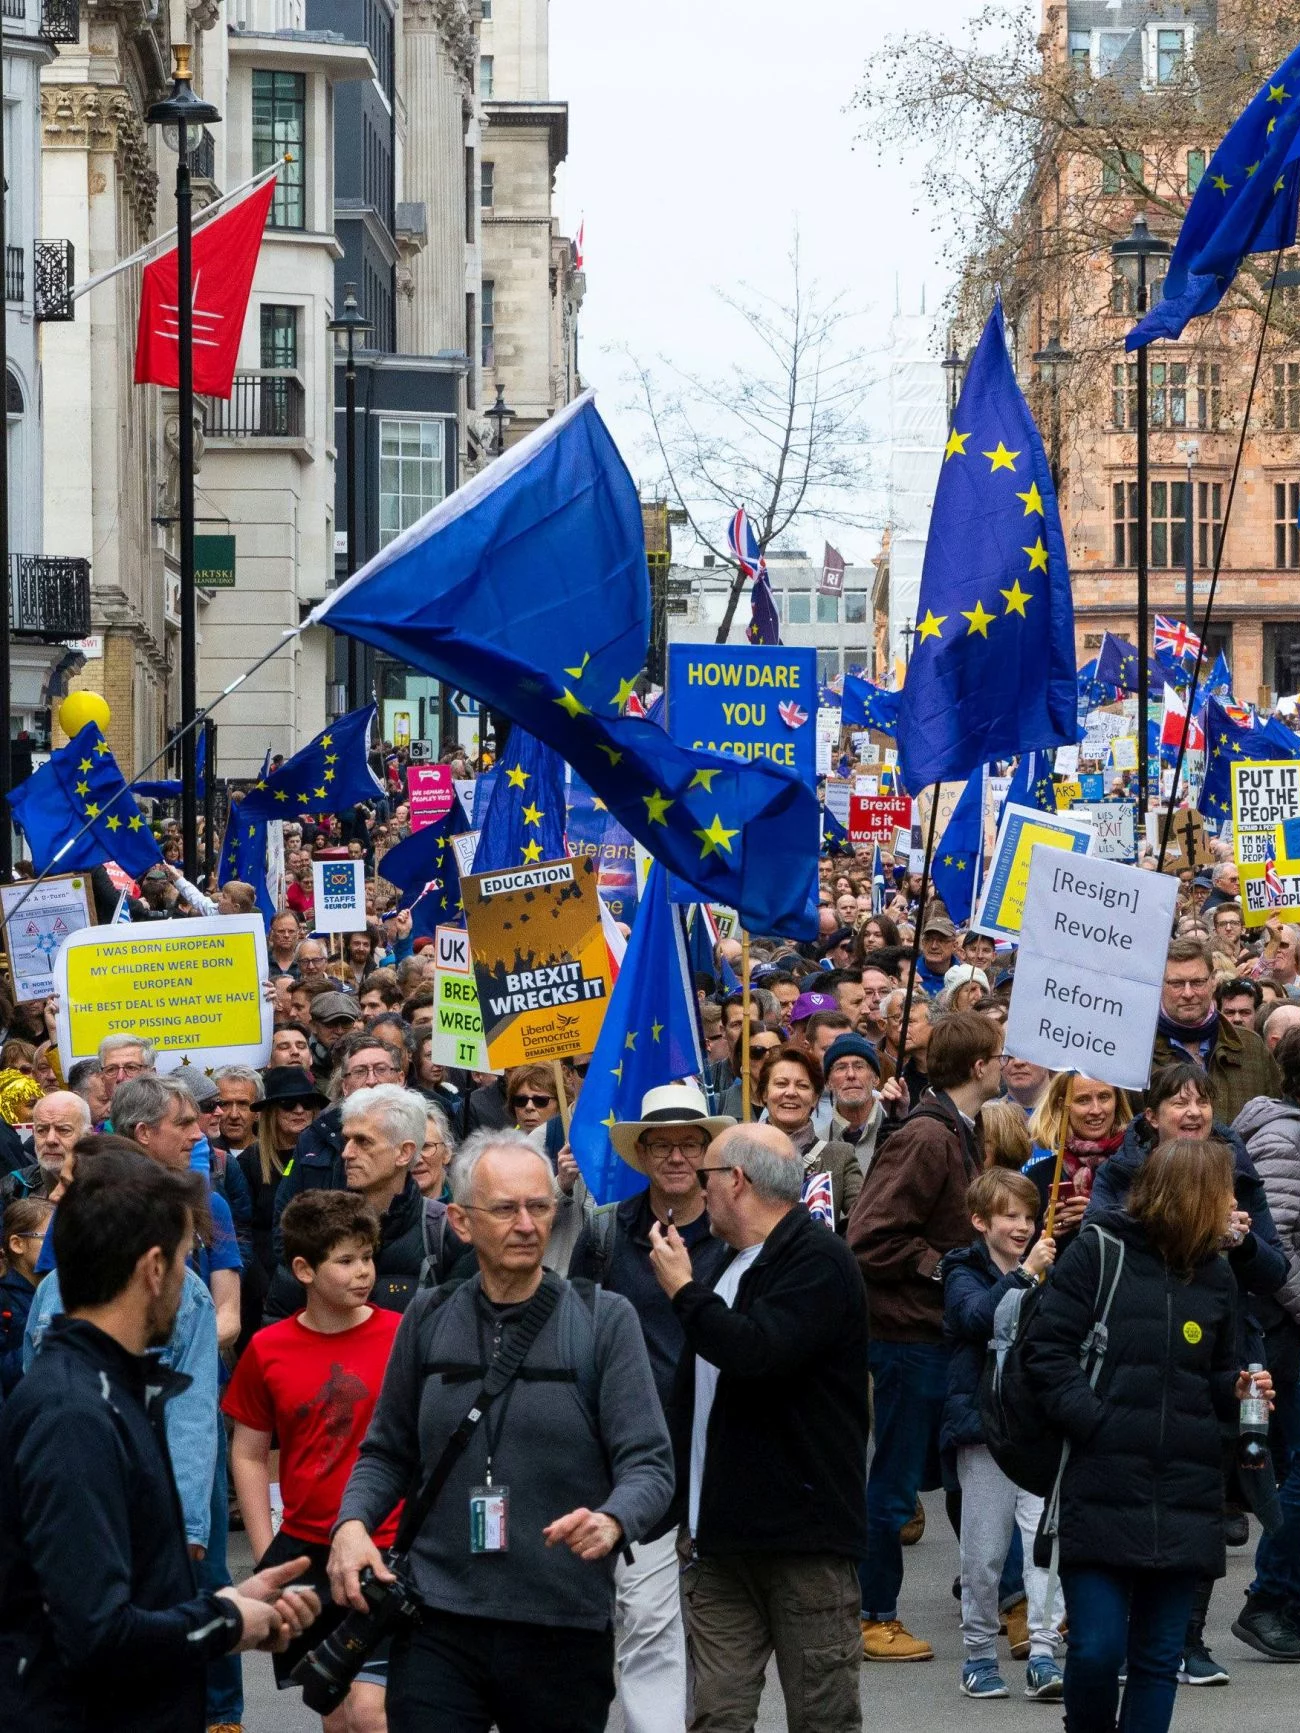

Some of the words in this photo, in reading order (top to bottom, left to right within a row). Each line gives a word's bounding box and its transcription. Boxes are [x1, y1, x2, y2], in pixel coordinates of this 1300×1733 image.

[194, 570, 233, 578] ARTSKI
[827, 573, 839, 585] Ri
[82, 639, 98, 648] SW1
[688, 663, 742, 686] HOW
[746, 665, 800, 688] DARE
[722, 703, 766, 726] YOU
[1238, 769, 1272, 789] PUT
[1281, 769, 1297, 786] IT
[860, 799, 906, 811] Brexit:
[1239, 789, 1260, 806] TO
[1266, 788, 1297, 805] THE
[871, 814, 881, 826] is
[884, 814, 893, 826] it
[1098, 812, 1113, 820] LIES
[1119, 804, 1133, 817] LIES
[1240, 806, 1298, 822] PEOPLE
[851, 830, 892, 841] worth
[567, 840, 636, 860] eterans
[1099, 845, 1114, 853] LIES
[1243, 844, 1253, 853] TO
[484, 867, 570, 893] EDUCATION
[1052, 868, 1139, 914] [Resign]
[1246, 883, 1266, 897] PUT
[1248, 897, 1265, 909] THE
[1054, 912, 1132, 950] Revoke
[96, 947, 100, 956] I
[103, 945, 128, 957] WAS
[131, 943, 161, 954] BORN
[166, 939, 225, 952] EUROPEAN
[440, 938, 465, 963] UK
[90, 965, 107, 976] MY
[112, 963, 164, 974] CHILDREN
[168, 960, 198, 971] WERE
[202, 958, 233, 968] BORN
[133, 977, 193, 990] EUROPEAN
[506, 963, 581, 992] BREXIT
[74, 1003, 93, 1013] THE
[97, 1001, 121, 1012] BEST
[126, 999, 152, 1009] DEAL
[156, 998, 165, 1008] IS
[169, 995, 201, 1006] WHAT
[205, 994, 223, 1004] WE
[226, 992, 255, 1002] HAVE
[490, 984, 578, 1015] WRECKS
[583, 979, 602, 998] IT
[1044, 978, 1123, 1017] Reform
[108, 1018, 136, 1030] STOP
[139, 1016, 181, 1028] PISSING
[185, 1013, 223, 1025] ABOUT
[521, 1022, 554, 1037] Liberal
[164, 1034, 200, 1045] BREXIT
[523, 1027, 580, 1047] Democrats
[1039, 1018, 1116, 1056] Rejoice
[460, 1044, 475, 1061] IT
[525, 1046, 555, 1057] DEMAND
[557, 1042, 581, 1052] BETTER
